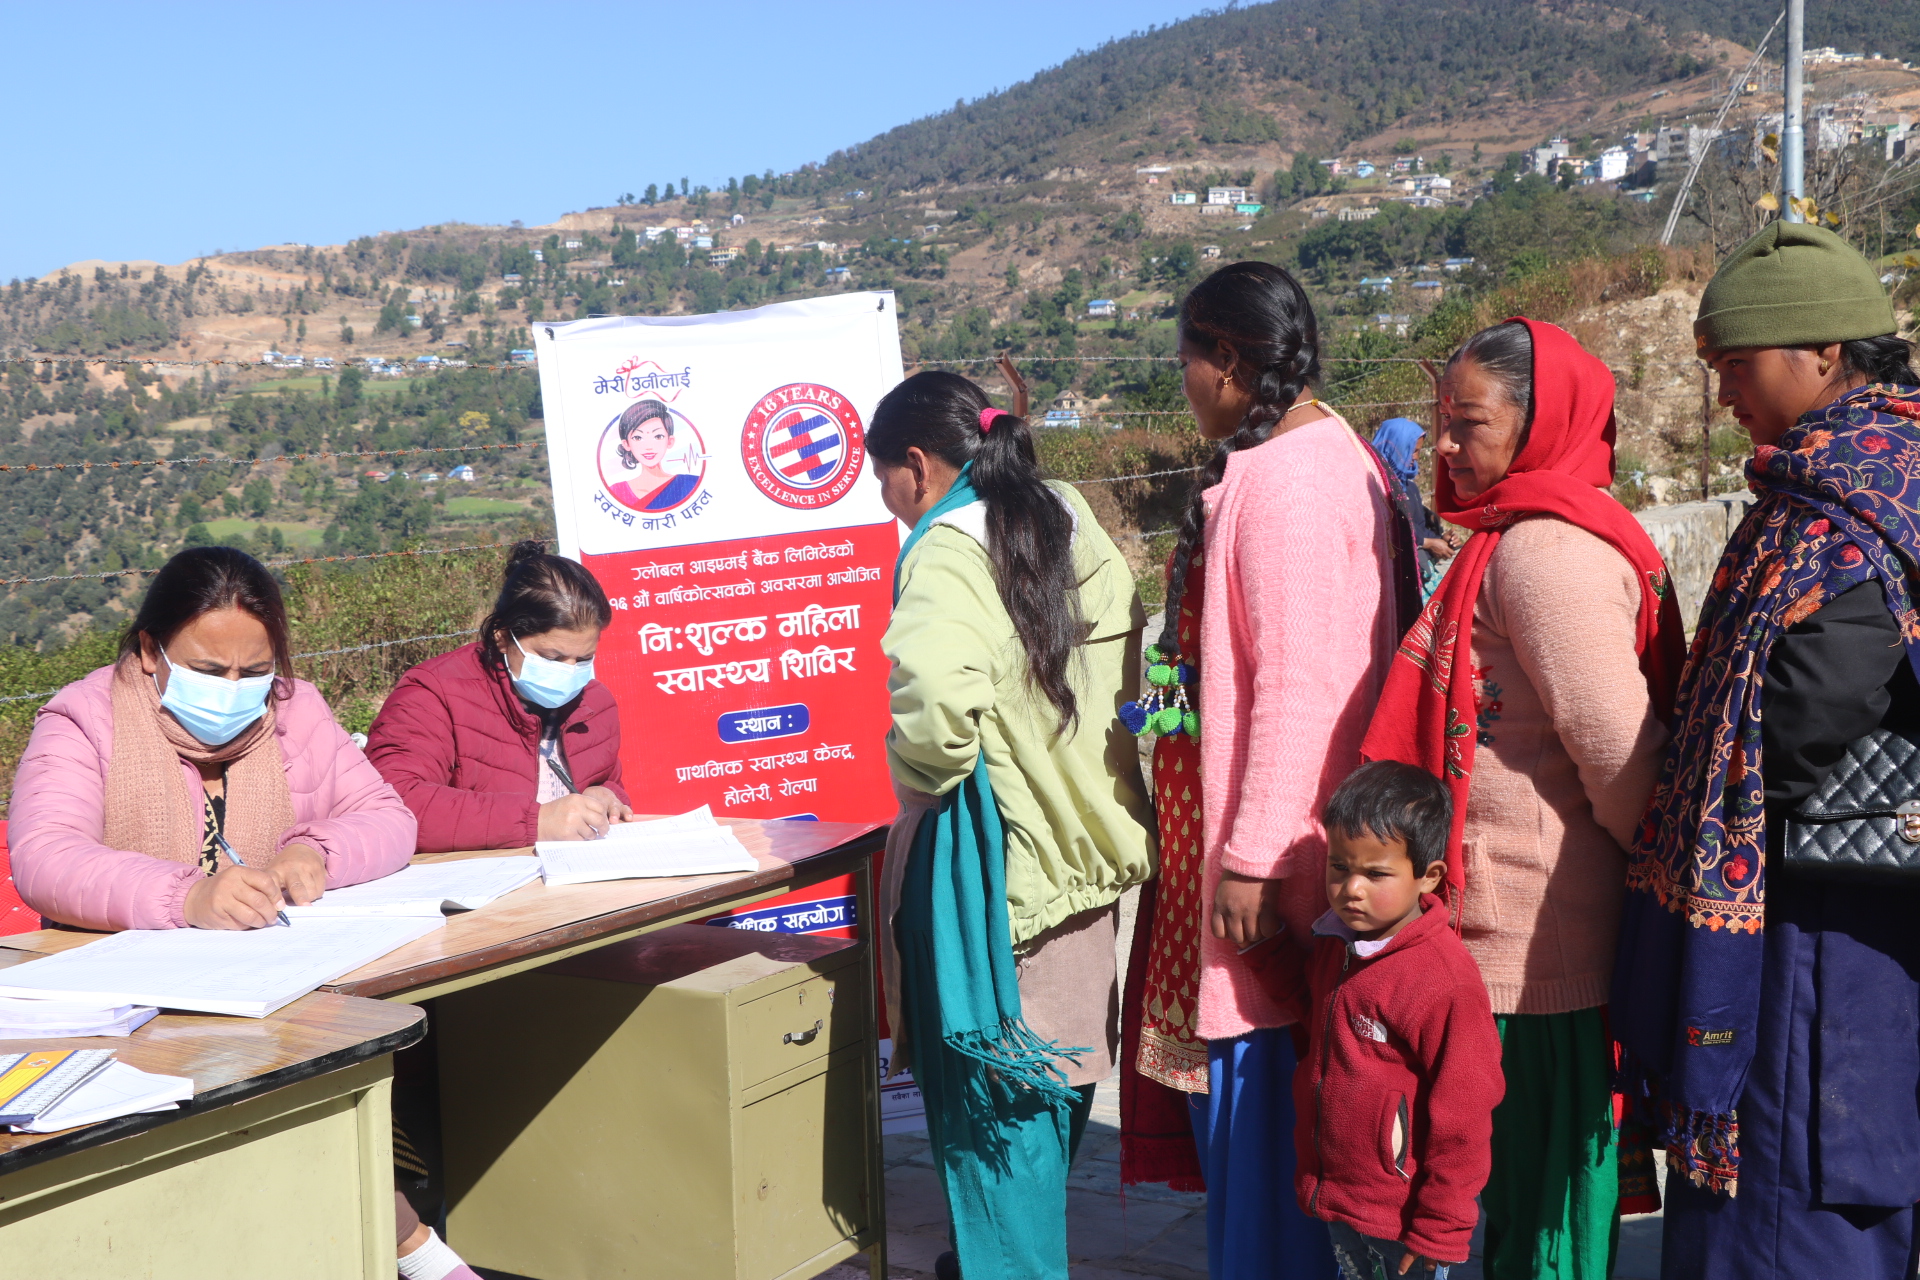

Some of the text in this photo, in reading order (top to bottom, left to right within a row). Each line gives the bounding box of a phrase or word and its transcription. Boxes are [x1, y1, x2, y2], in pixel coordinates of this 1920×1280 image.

[593, 366, 691, 395] मेरी उनीलाई
[757, 386, 842, 420] 16 YEARS
[748, 446, 861, 505] EXCELLENCE IN SERVICE
[593, 488, 713, 532] स्वस्थ नारी पहल
[631, 539, 854, 581] ग्लोबल आइएमई बैंक लिमिटेडको
[609, 596, 628, 611] १६
[655, 578, 755, 605] वार्षिकोत्सवको
[761, 573, 822, 594] अवसरमा
[827, 565, 881, 587] आयोजित
[776, 603, 862, 638] महिला
[654, 646, 857, 695] स्वास्थ्य शिविर
[734, 713, 781, 735] स्थान
[676, 742, 856, 784] प्राथमिक स्वास्थ्य केन्द्र,
[723, 777, 818, 808] होलेरी, रोल्पा
[782, 904, 844, 929] सहयोग
[1703, 1031, 1733, 1040] Amrit
